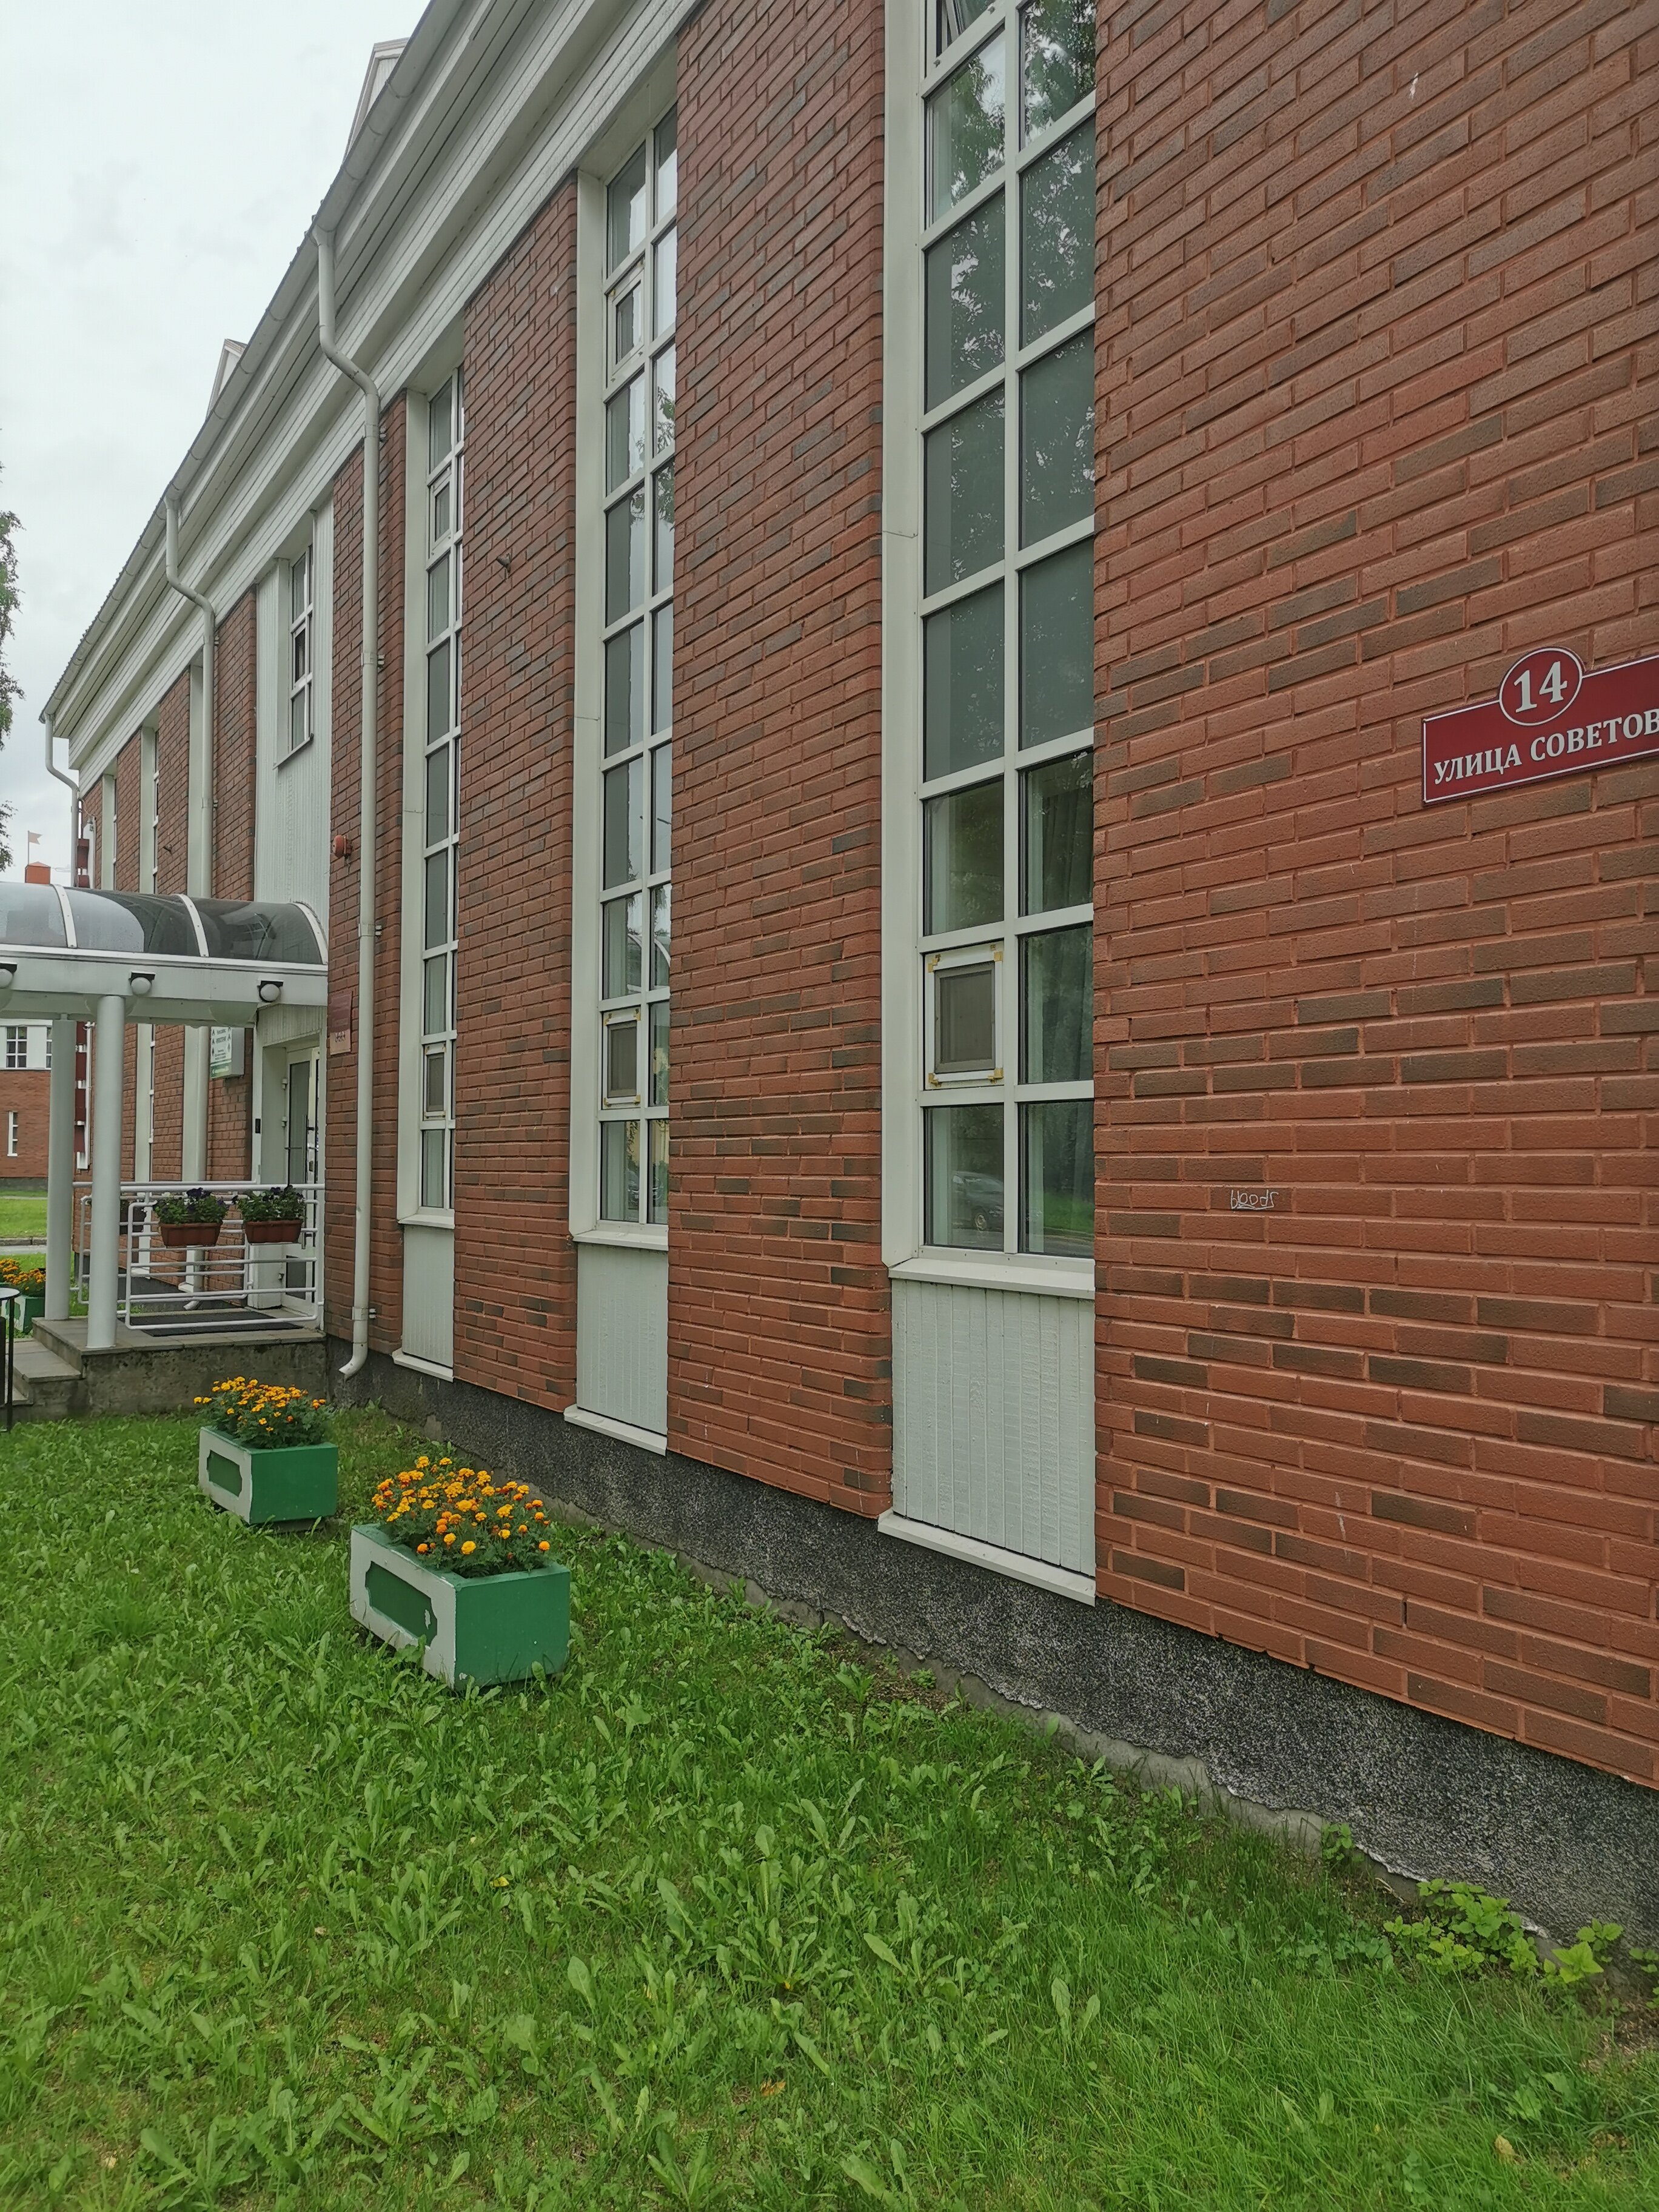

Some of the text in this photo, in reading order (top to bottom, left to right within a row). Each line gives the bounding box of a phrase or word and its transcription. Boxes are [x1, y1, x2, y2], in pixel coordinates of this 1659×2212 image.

[1513, 661, 1567, 713] 14
[1433, 708, 1659, 785] УЛИЦА СОВЕТОВ
